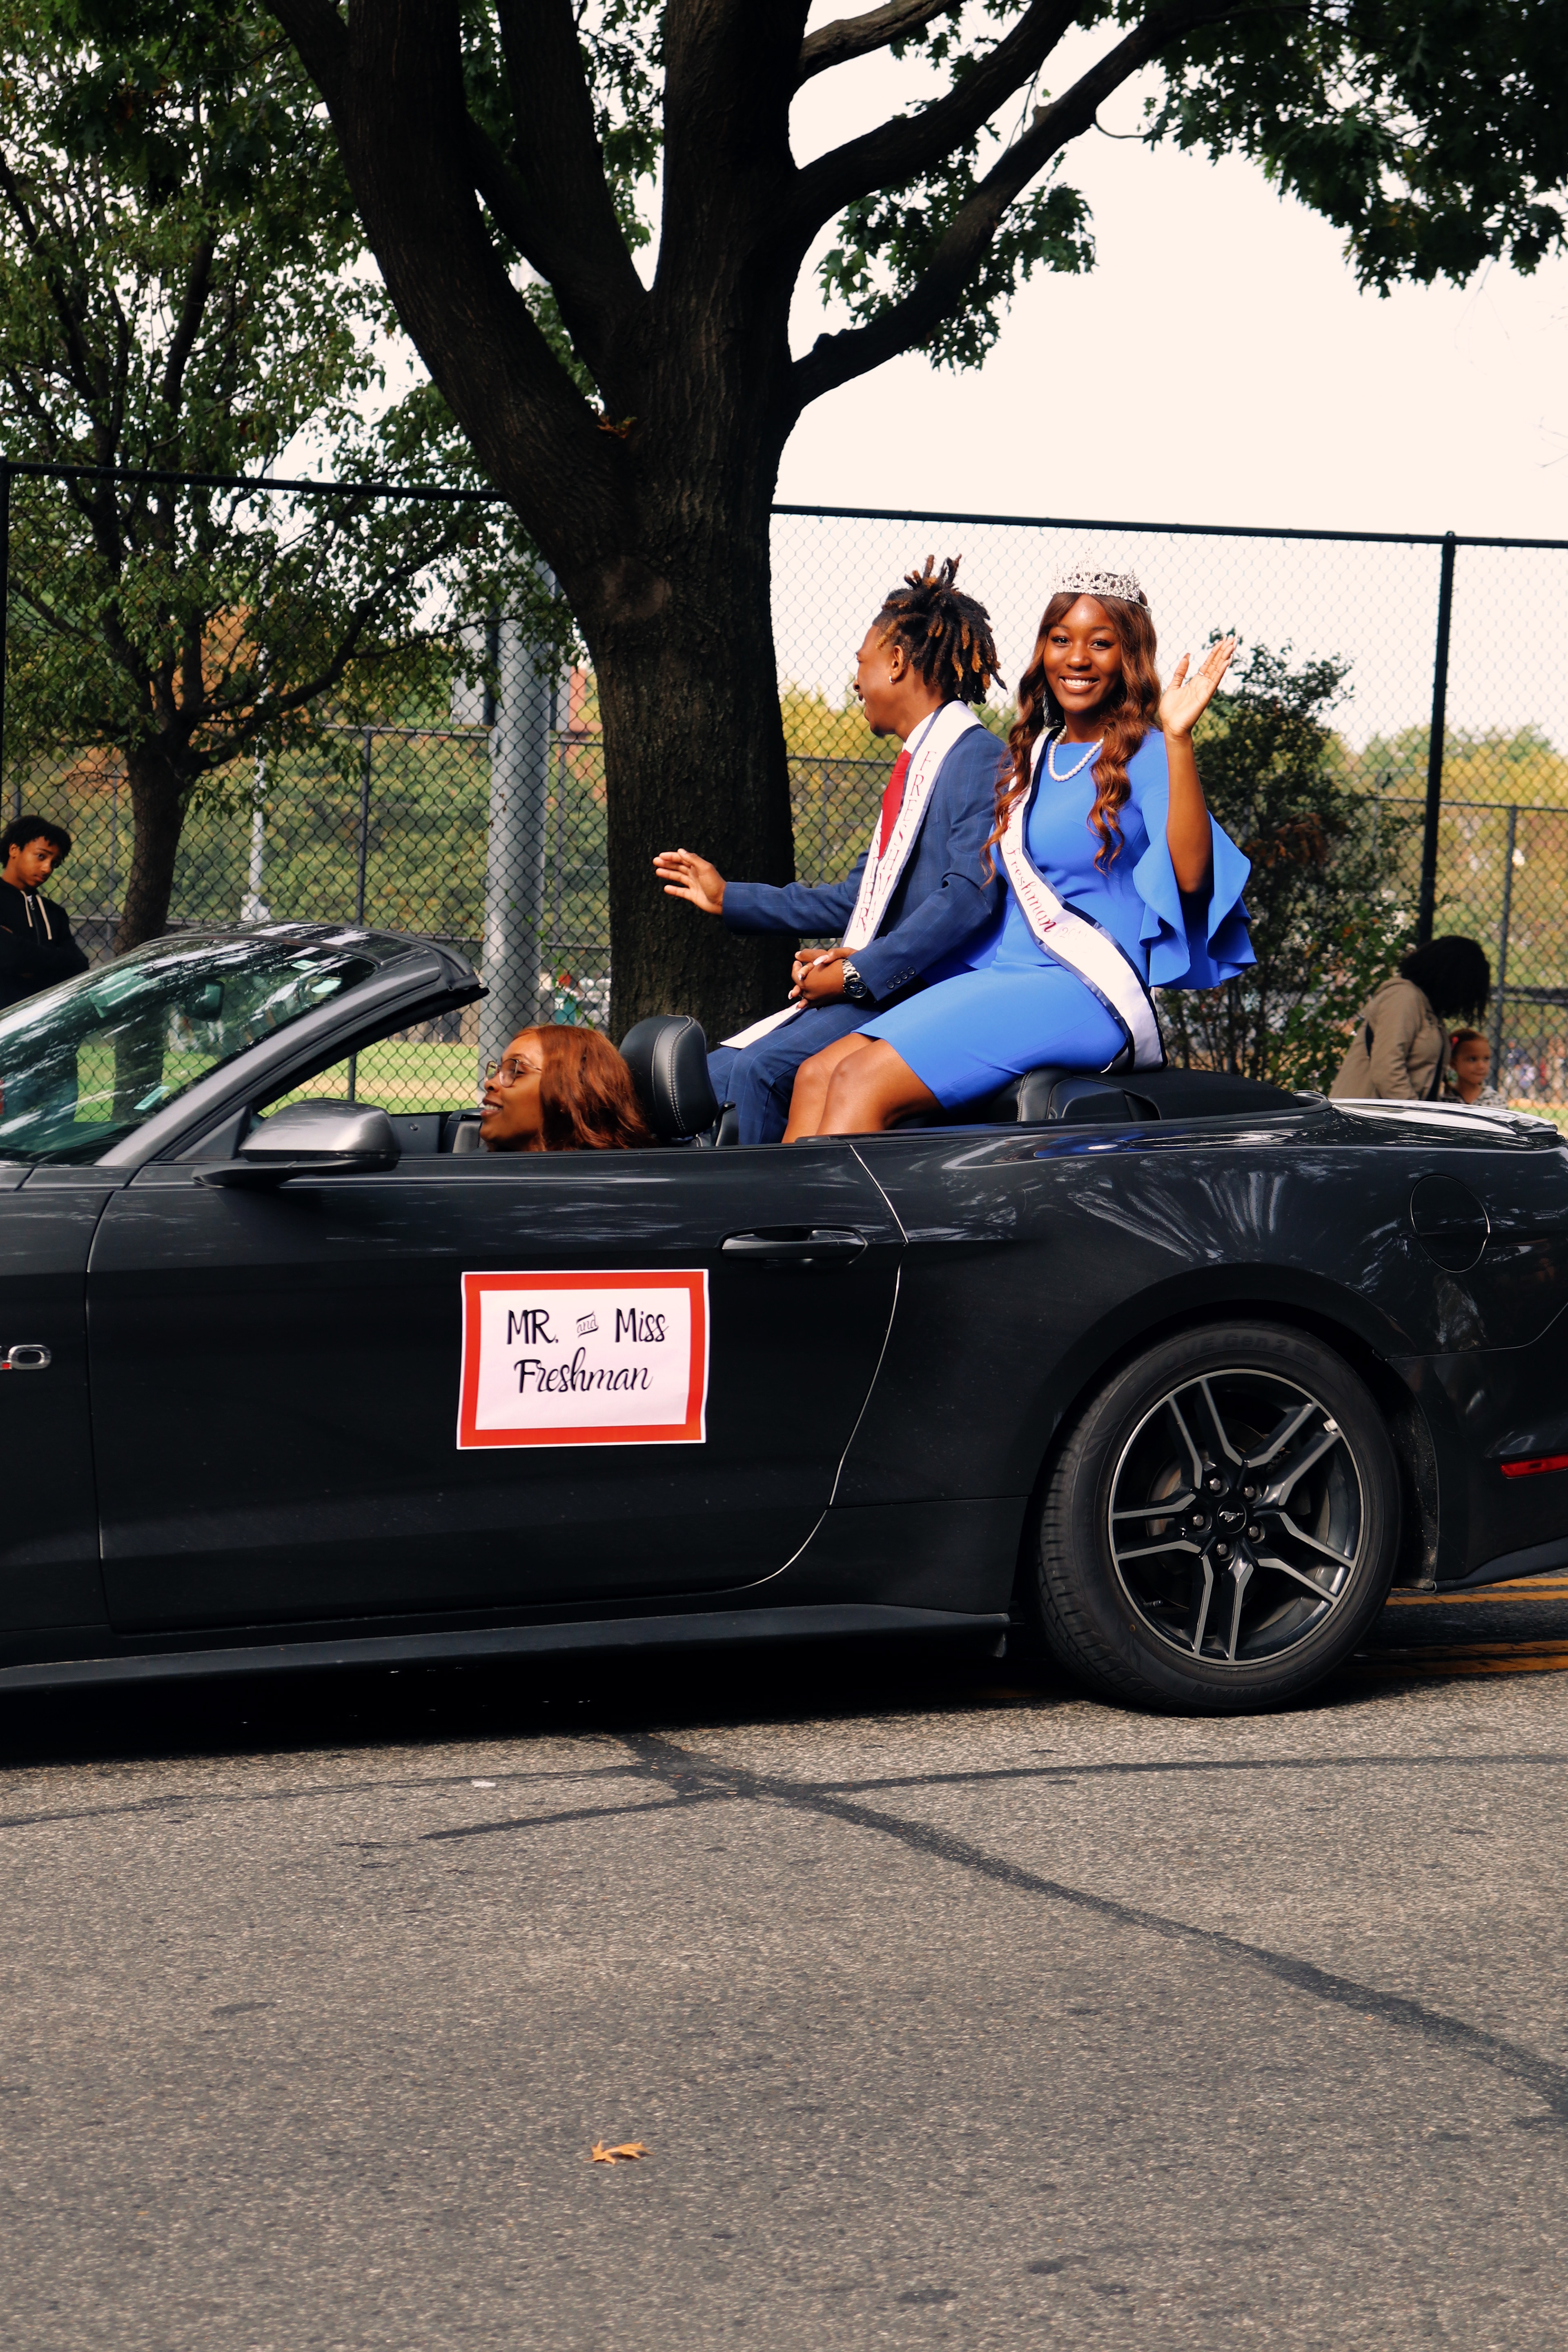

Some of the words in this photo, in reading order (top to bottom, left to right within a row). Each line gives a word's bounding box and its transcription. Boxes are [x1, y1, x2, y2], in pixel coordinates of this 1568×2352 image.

[1004, 834, 1057, 932] Freshman
[506, 1309, 559, 1345] MR.
[576, 1310, 599, 1337] and
[615, 1307, 669, 1343] Miss
[513, 1347, 653, 1394] Freshman
